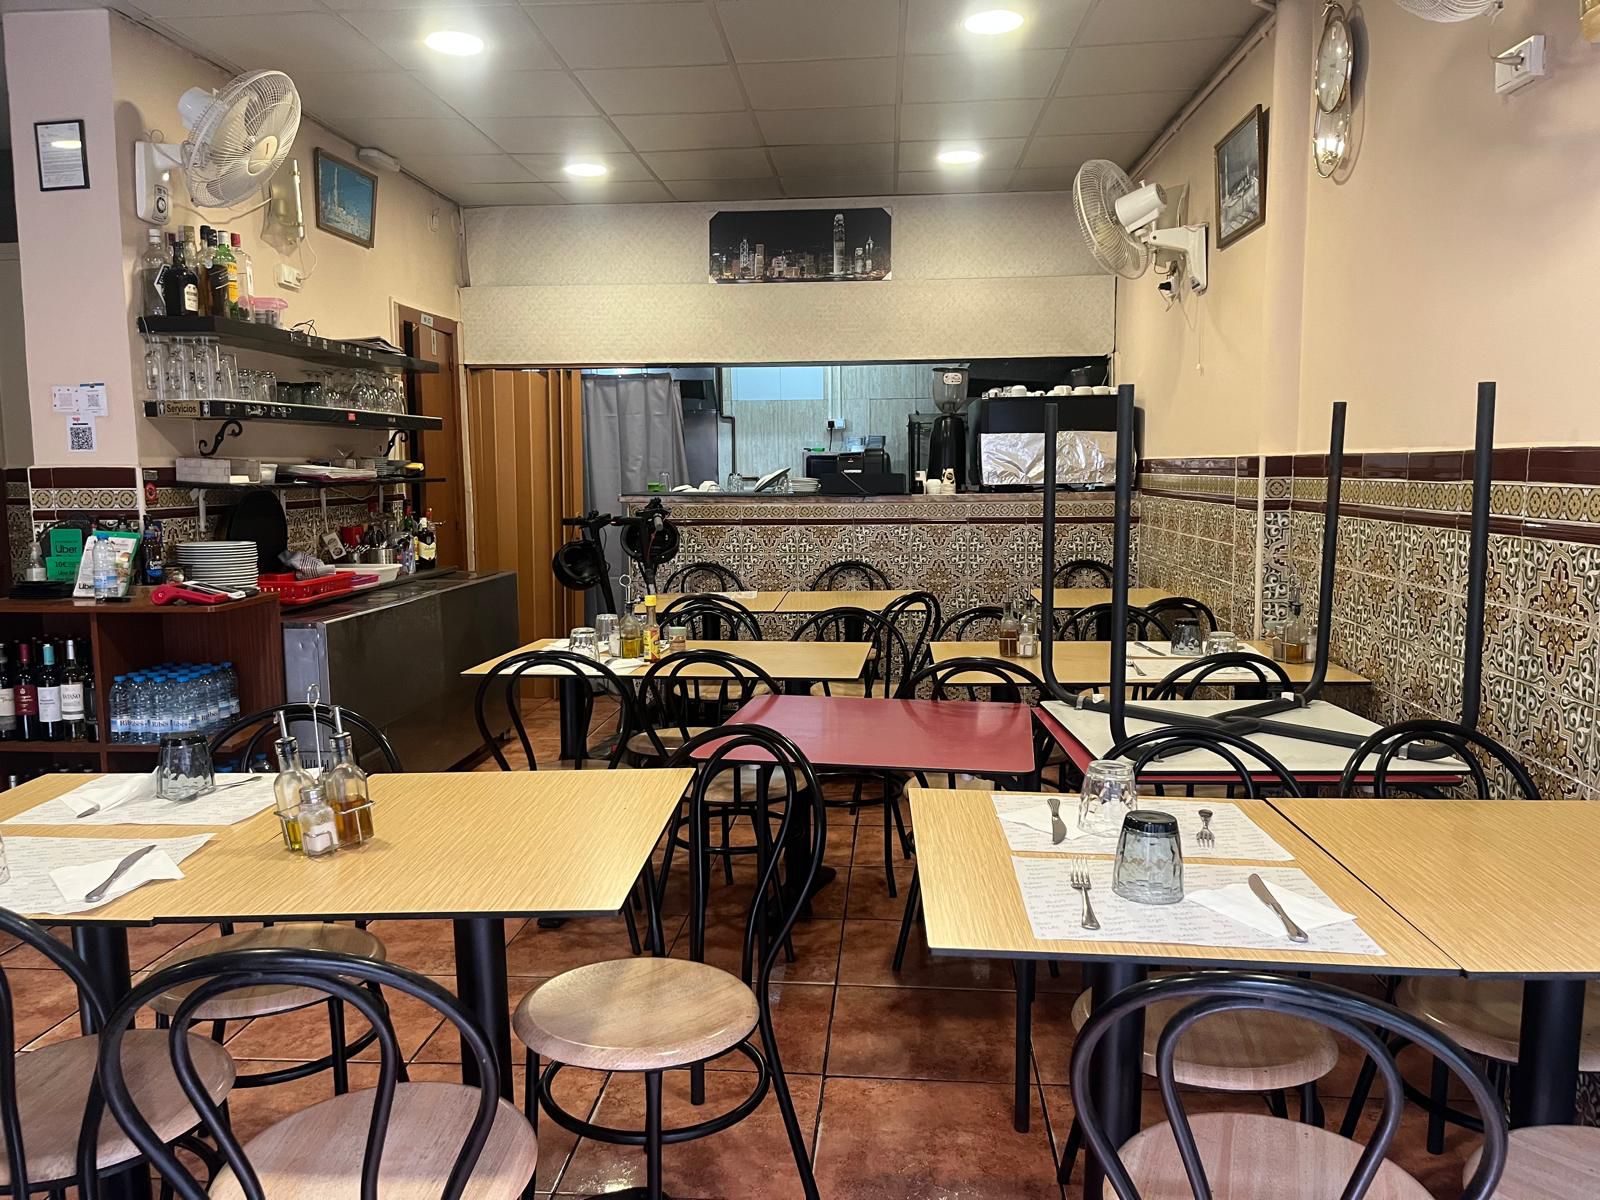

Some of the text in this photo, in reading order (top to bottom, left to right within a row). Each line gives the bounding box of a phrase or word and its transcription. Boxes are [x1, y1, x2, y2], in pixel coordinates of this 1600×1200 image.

[167, 404, 196, 413] Servicios
[55, 544, 77, 554] Uber
[78, 582, 95, 590] Ube
